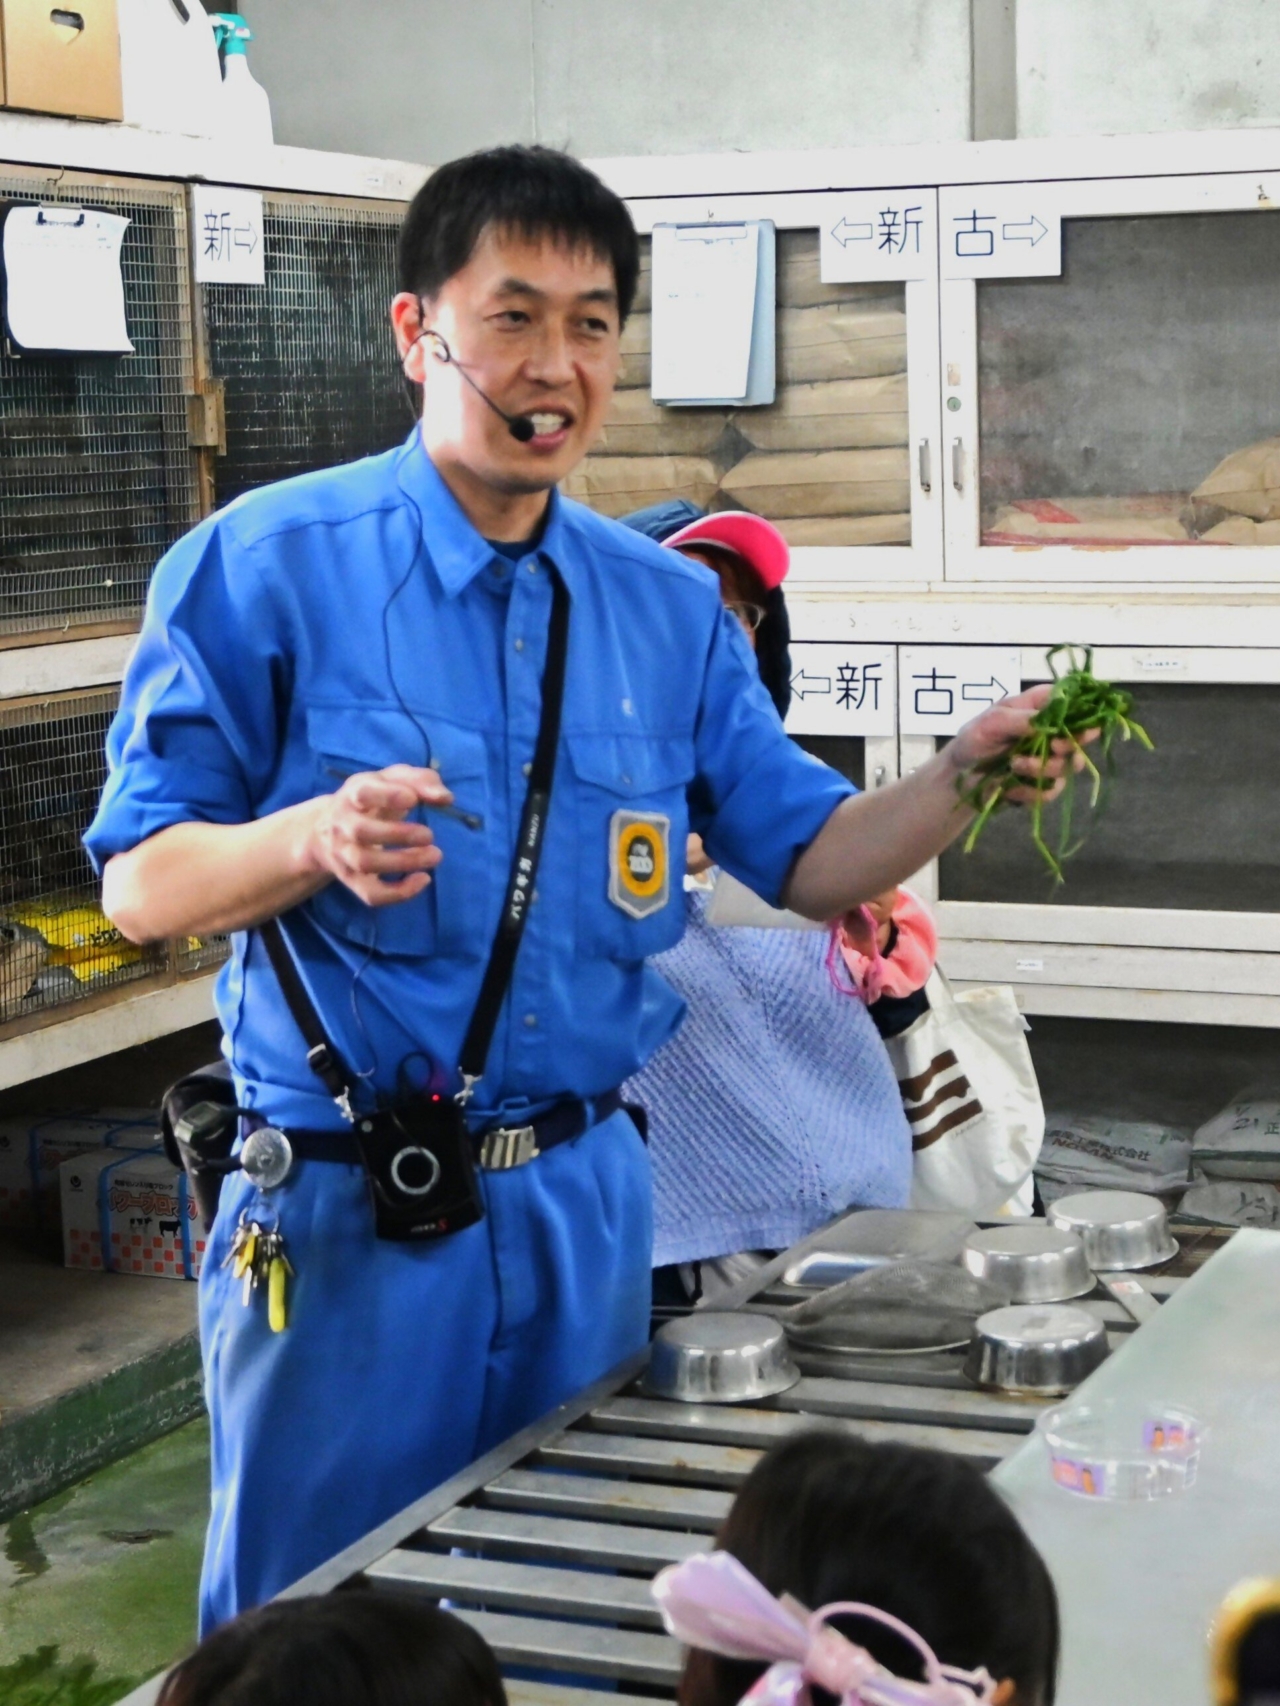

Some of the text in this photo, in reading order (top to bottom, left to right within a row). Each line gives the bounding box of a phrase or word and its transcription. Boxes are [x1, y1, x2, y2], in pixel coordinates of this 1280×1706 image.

[203, 208, 232, 262] 新
[878, 206, 924, 255] 新
[952, 208, 997, 257] 古
[836, 661, 883, 711] 新
[911, 666, 957, 715] 古
